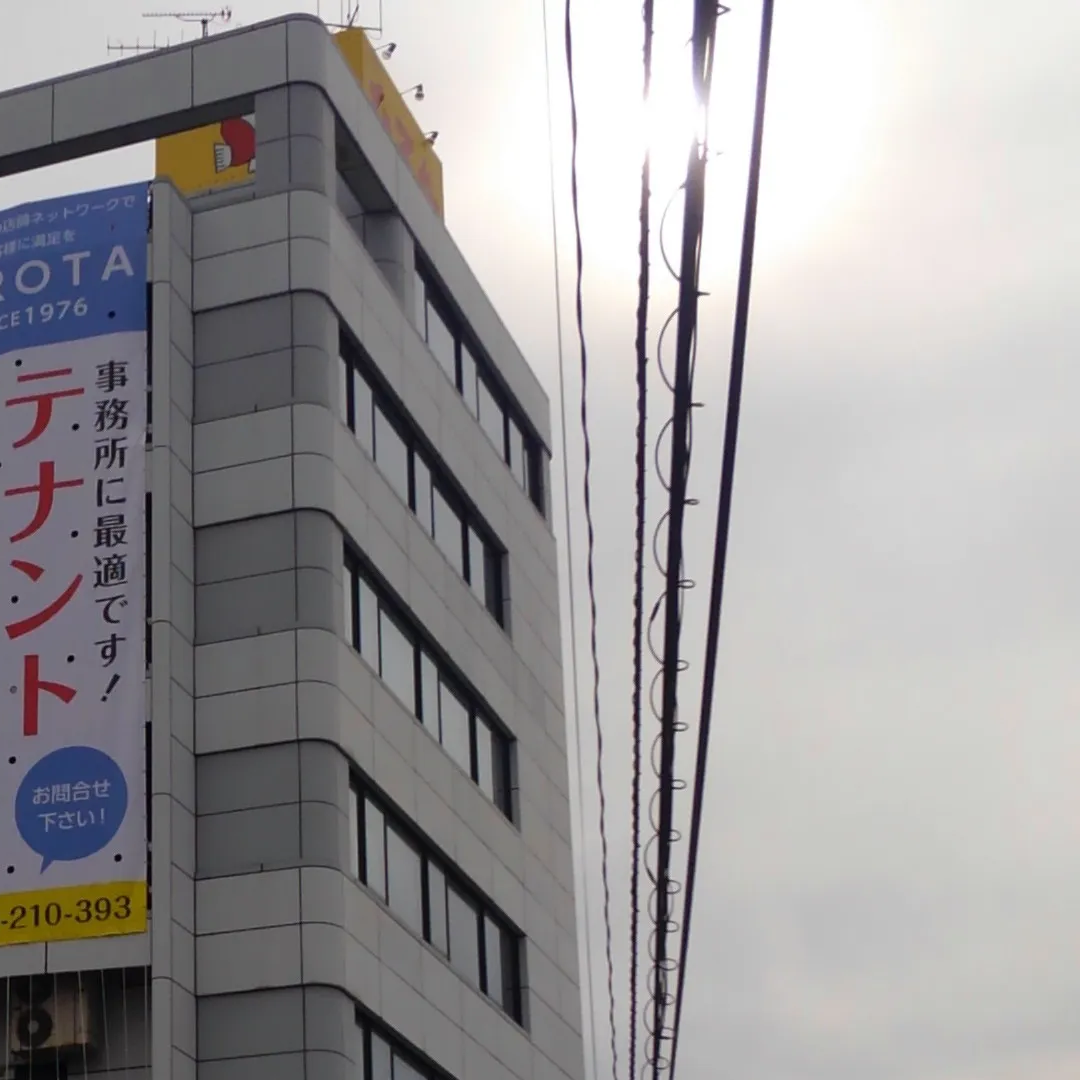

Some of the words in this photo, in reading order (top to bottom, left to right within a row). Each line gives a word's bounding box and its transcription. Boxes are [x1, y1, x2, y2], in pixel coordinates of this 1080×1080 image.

[5, 367, 86, 736] テナント
[93, 360, 130, 702] 事務所に最適です!
[32, 778, 111, 806] お問合せ
[38, 808, 106, 833] 下さい!
